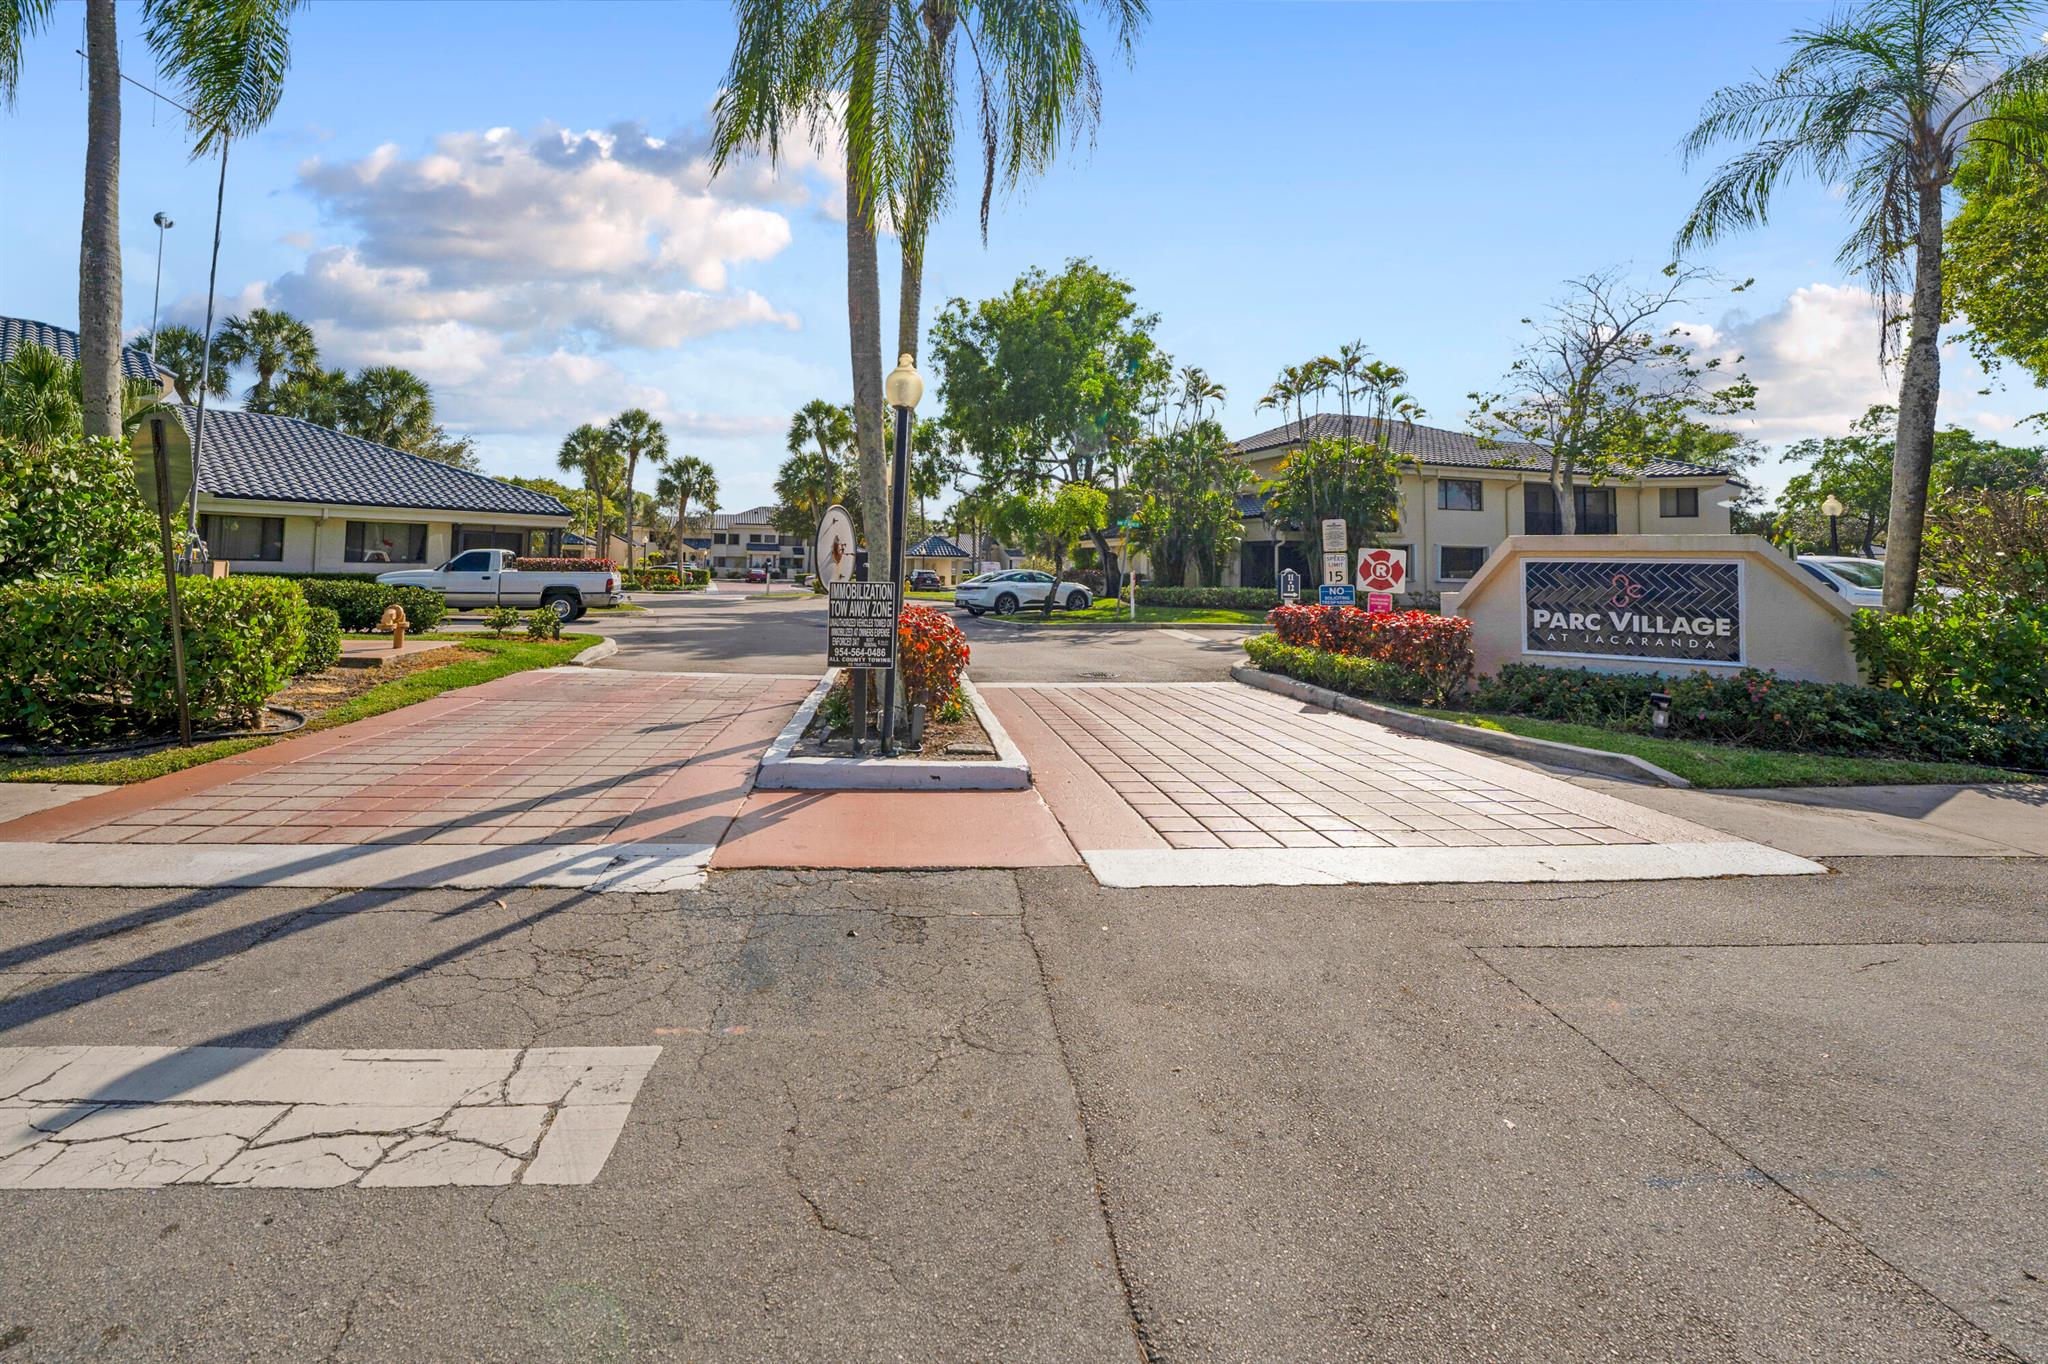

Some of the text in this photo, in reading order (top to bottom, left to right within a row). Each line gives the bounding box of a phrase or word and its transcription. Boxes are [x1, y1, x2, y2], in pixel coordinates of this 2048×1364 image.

[1376, 564, 1387, 576] R
[1329, 571, 1343, 582] 15
[830, 584, 893, 600] IMMOBILIZATION
[1287, 584, 1295, 592] 12
[1329, 587, 1345, 595] NO
[830, 600, 893, 617] TOW AWAY ZONE
[829, 618, 856, 627] UNAUTHORIZED
[857, 618, 873, 627] VEHICLES
[874, 618, 886, 628] TOWED
[1533, 609, 1731, 637] PARC VILLAGE
[831, 627, 891, 637] IMMOBILIZED AT OWNERS EXPENSE
[832, 637, 851, 646] ENFORCED
[1547, 633, 1715, 649] AT JACARANDA
[834, 647, 886, 657] 954-564-0486
